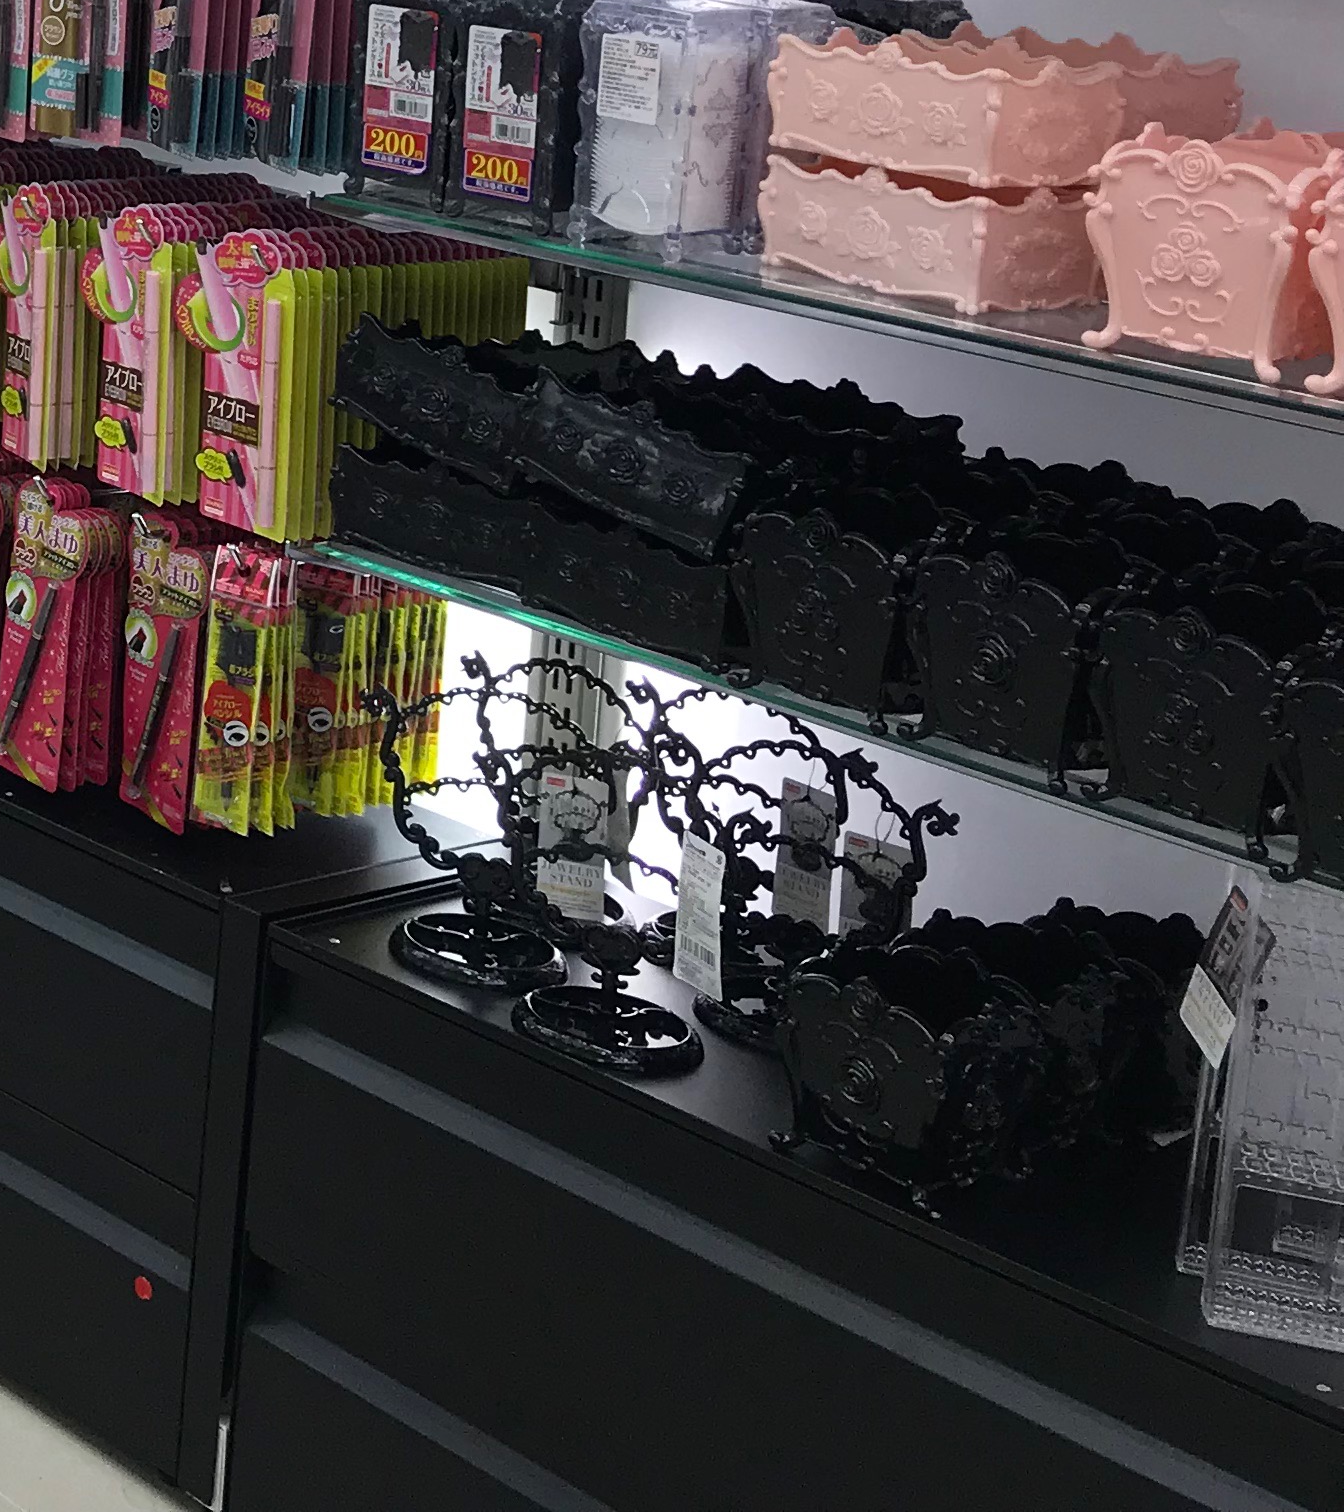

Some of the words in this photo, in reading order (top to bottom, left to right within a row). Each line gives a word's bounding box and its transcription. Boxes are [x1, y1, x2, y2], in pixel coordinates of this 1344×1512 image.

[370, 128, 424, 160] 200円
[470, 153, 527, 186] 200円
[104, 364, 144, 392] アイブロー
[207, 394, 256, 425] アイブロー
[17, 513, 80, 555] 美人まゆ
[133, 547, 201, 593] 美人まゆ
